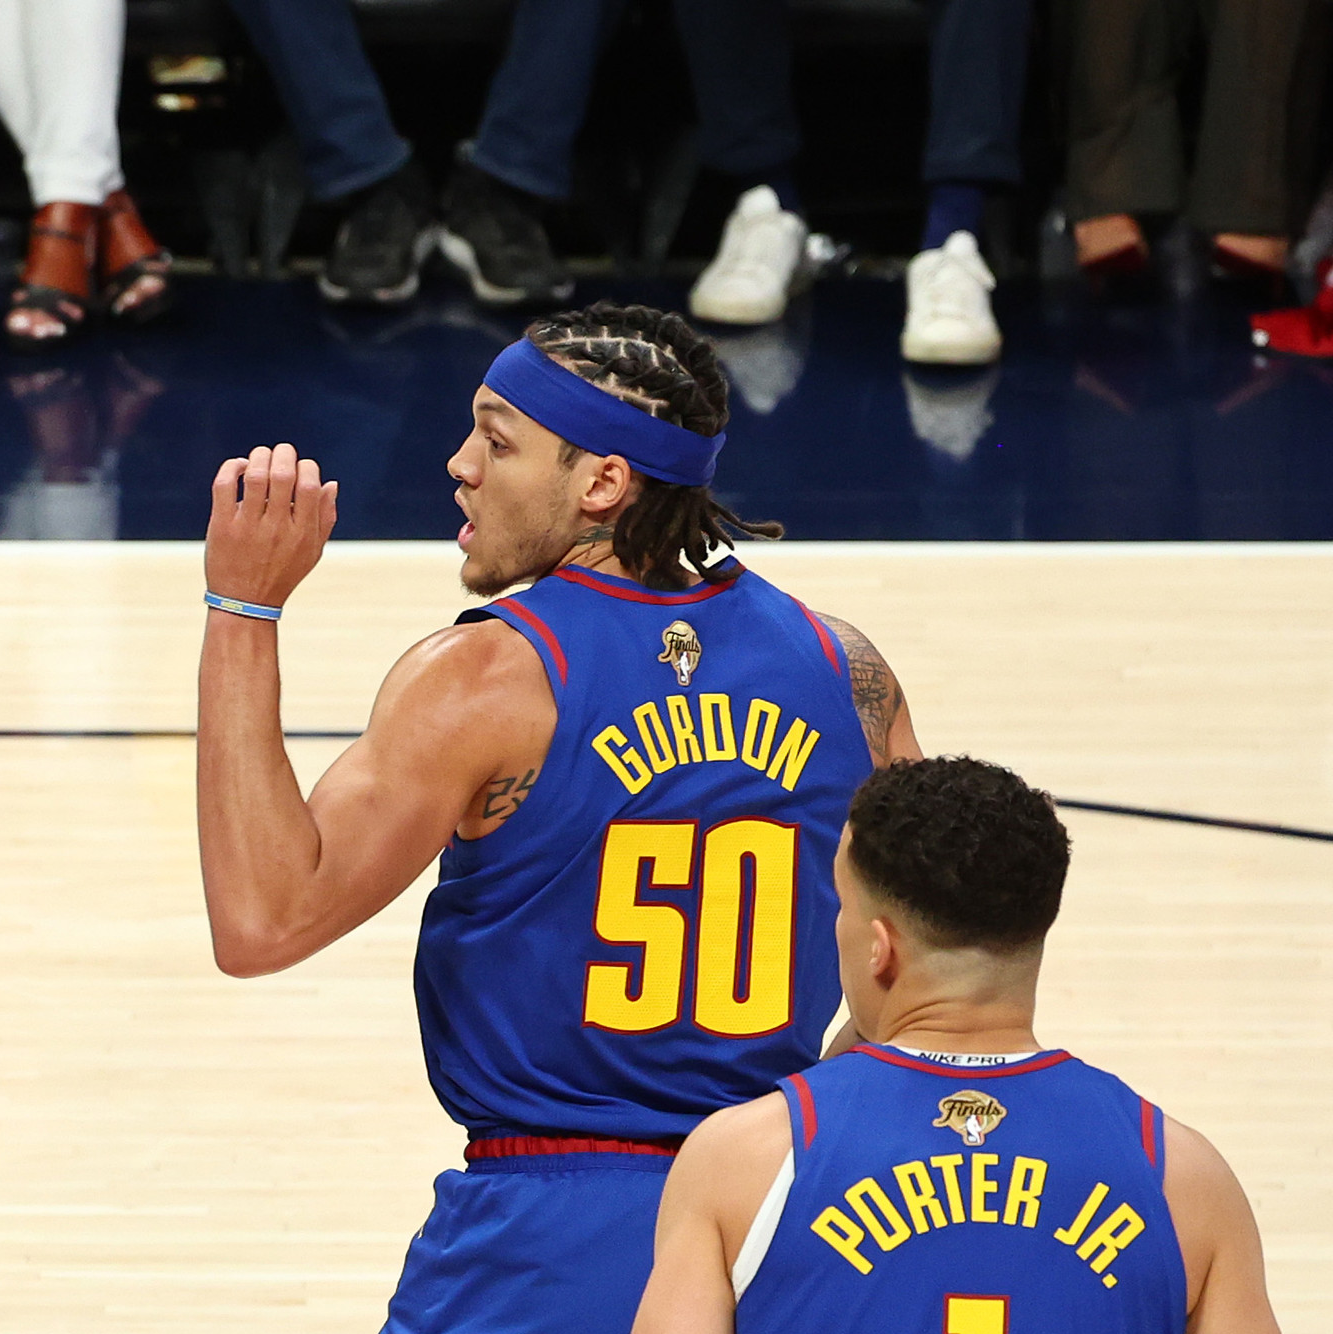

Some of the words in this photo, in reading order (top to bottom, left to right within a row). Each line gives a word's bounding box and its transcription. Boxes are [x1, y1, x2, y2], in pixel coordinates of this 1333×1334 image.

[661, 630, 701, 660] Finals
[590, 692, 822, 796] GORDON
[580, 814, 802, 1040] 50
[918, 1051, 963, 1066] NIKE
[966, 1055, 1006, 1066] PRO
[938, 1098, 1004, 1125] Finals
[809, 1152, 1050, 1276] PORTER
[1052, 1181, 1147, 1290] JR.
